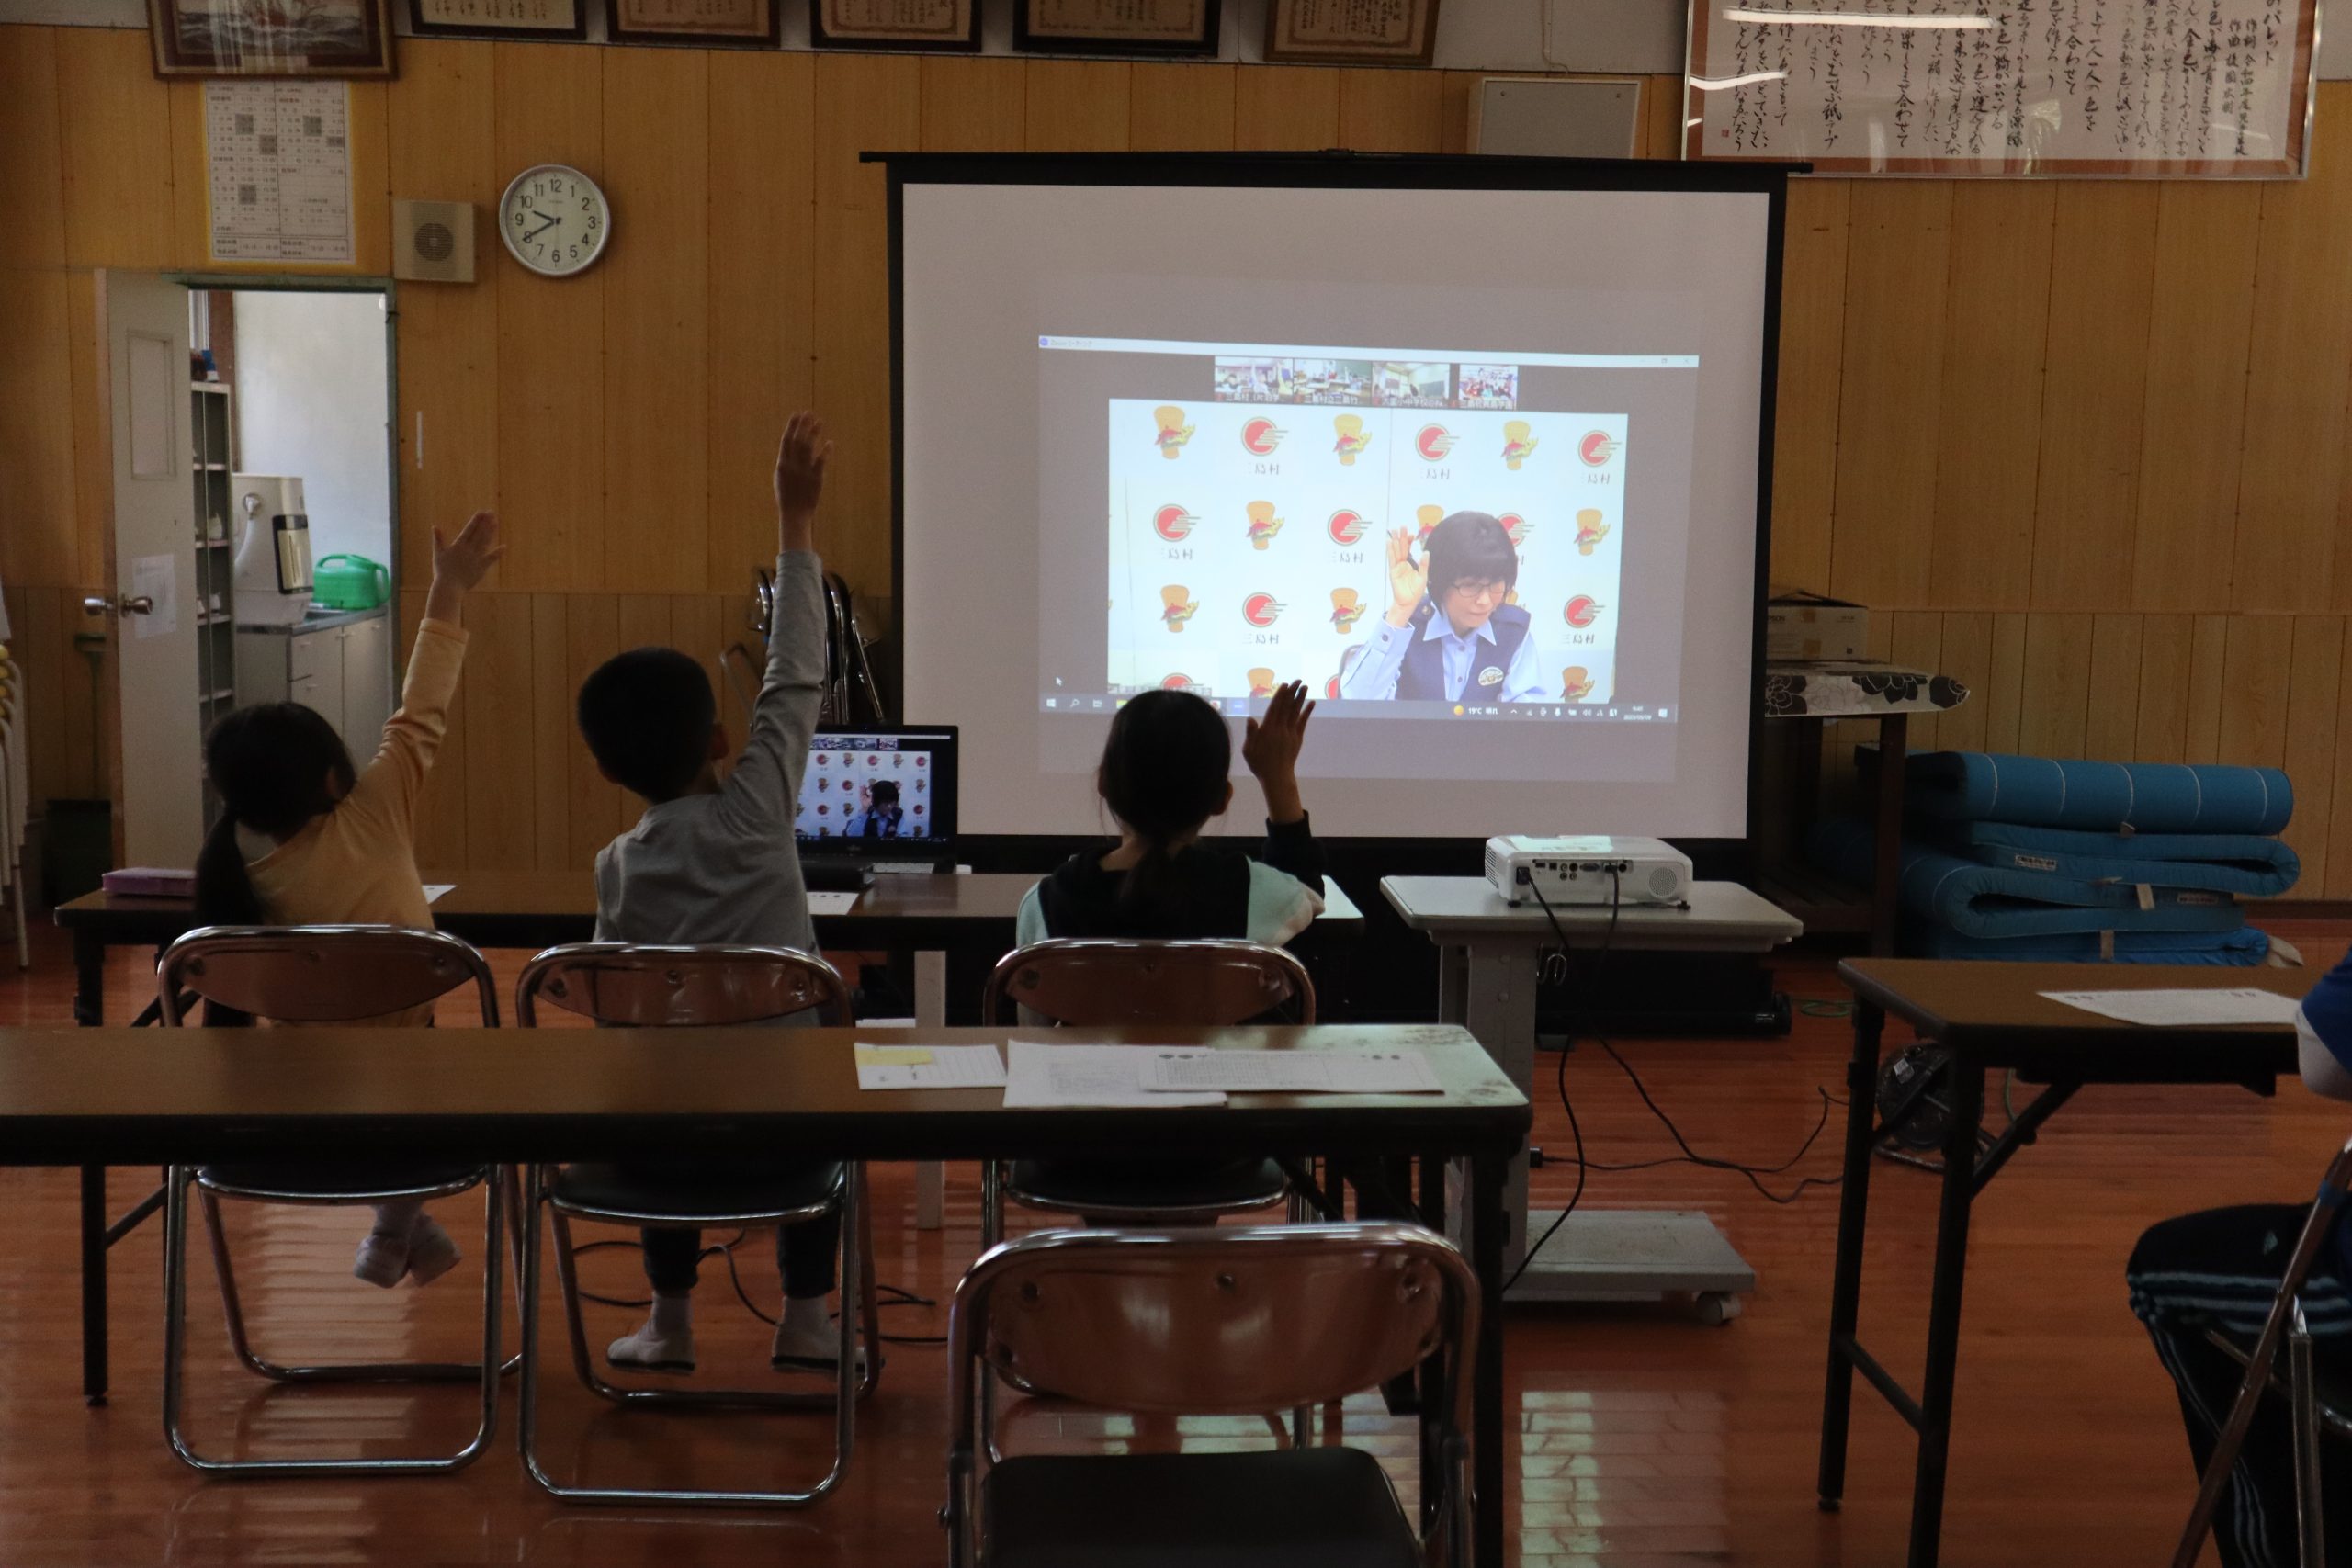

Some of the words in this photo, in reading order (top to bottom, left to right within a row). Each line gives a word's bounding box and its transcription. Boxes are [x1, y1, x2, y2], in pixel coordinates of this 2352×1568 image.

[534, 184, 544, 197] 11
[550, 179, 562, 192] 12
[520, 195, 533, 209] 10
[582, 197, 590, 210] 2
[514, 212, 524, 226] 9
[588, 216, 596, 229] 3
[582, 233, 589, 245] 4
[536, 243, 544, 256] 7
[570, 245, 578, 258] 5
[551, 250, 560, 263] 6
